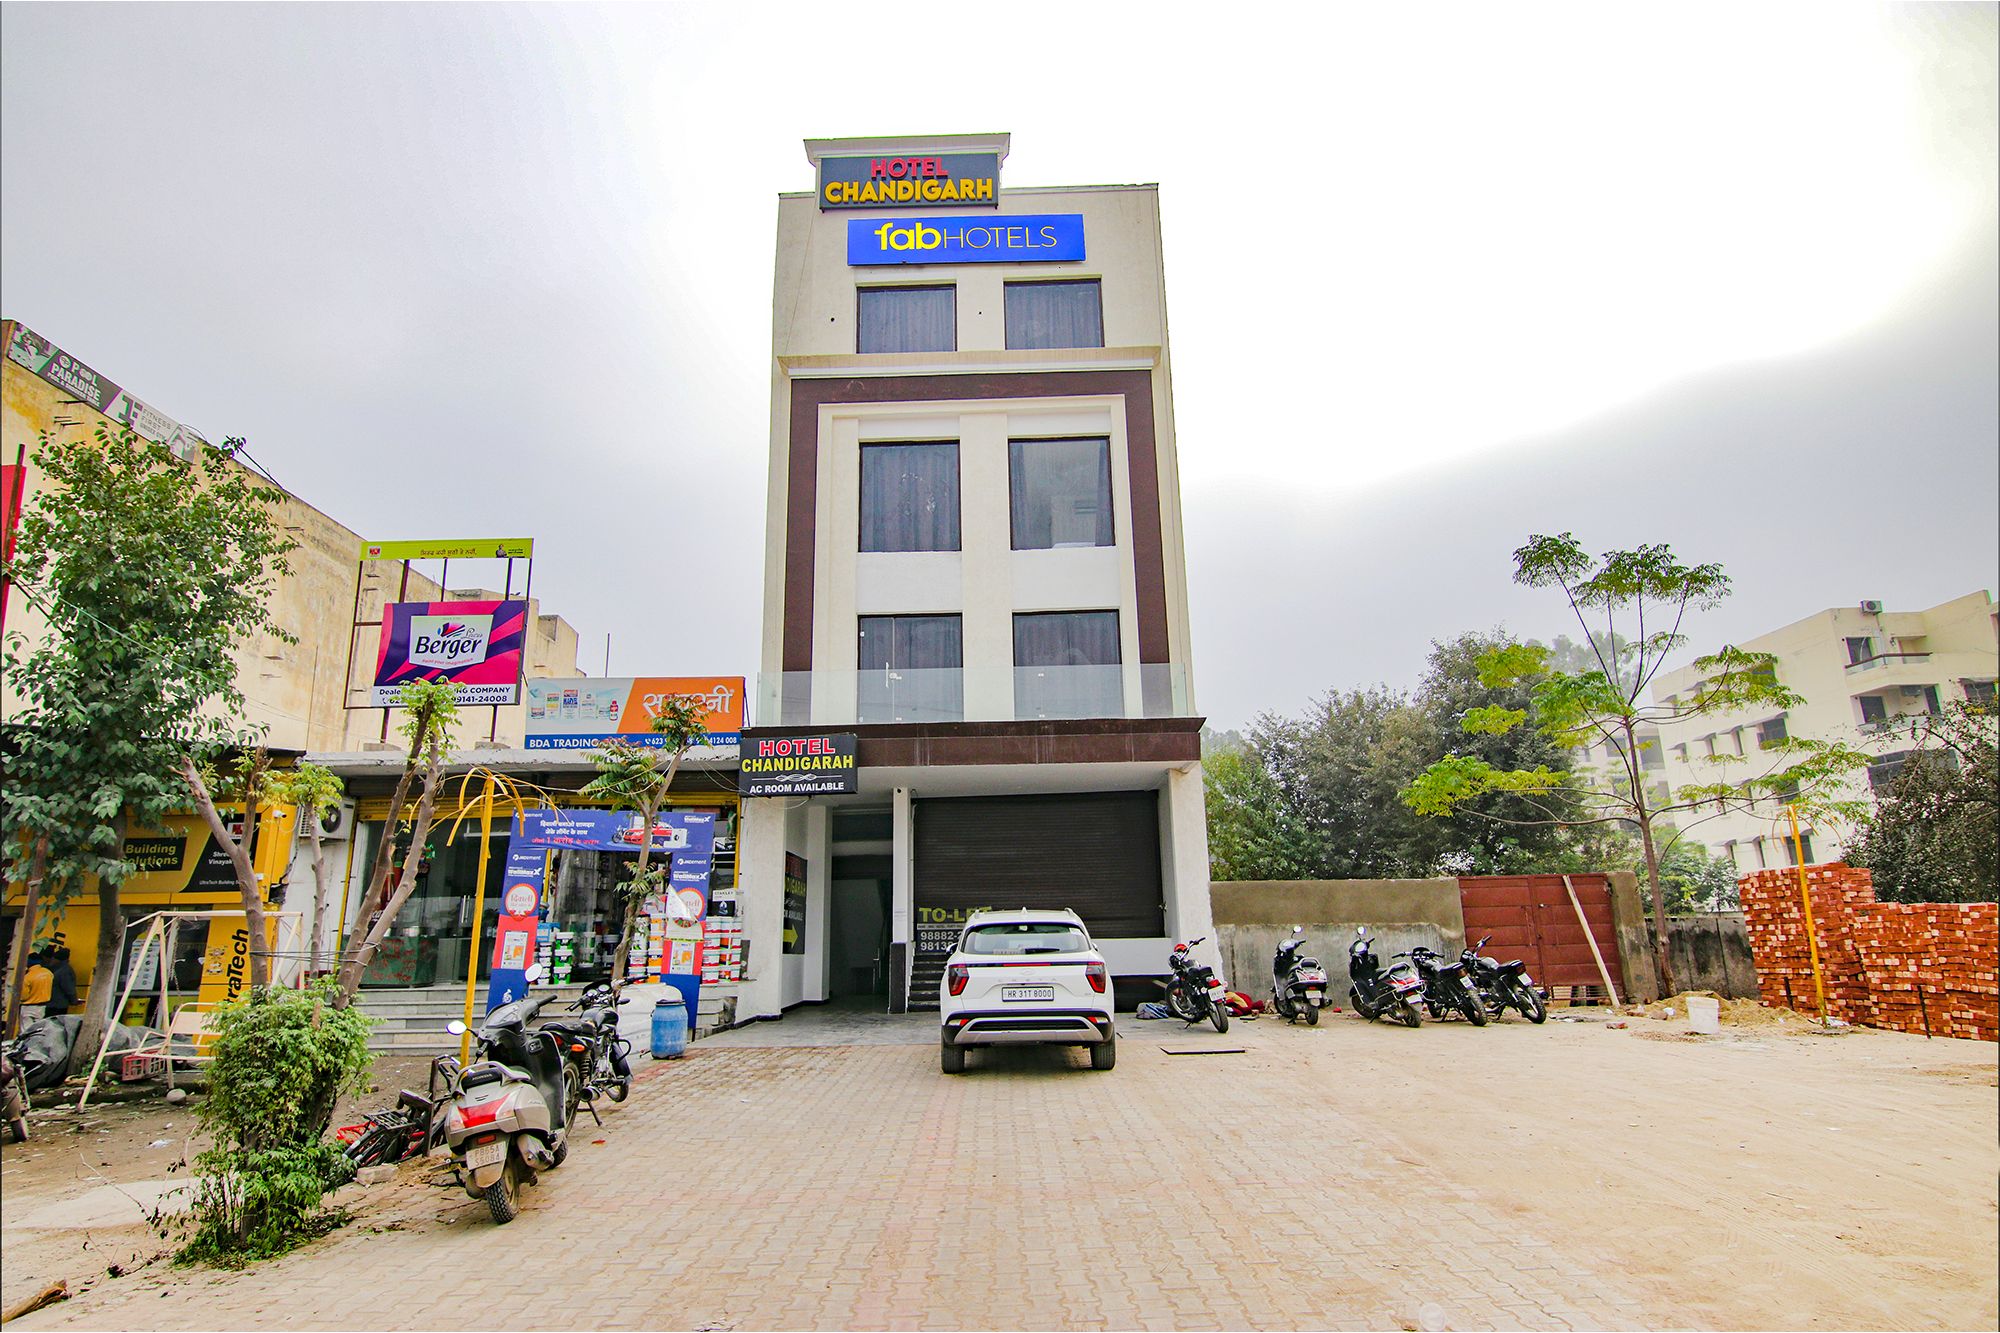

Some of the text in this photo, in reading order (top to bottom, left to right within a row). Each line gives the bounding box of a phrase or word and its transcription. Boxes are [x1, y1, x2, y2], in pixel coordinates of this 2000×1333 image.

[871, 158, 949, 180] HOTEL
[825, 179, 993, 204] CHANDIGARH
[50, 362, 101, 401] PARADISE
[142, 416, 161, 430] FIRST
[143, 408, 171, 430] FITNESS
[415, 636, 481, 659] Berger
[529, 738, 600, 748] BDA TRADING
[651, 737, 663, 745] 623
[725, 736, 737, 744] 008
[759, 738, 836, 757] HOTEL
[741, 755, 853, 772] CHANDIGARAH
[750, 782, 845, 793] AC ROOM AVAILABLE
[126, 844, 176, 855] Building
[920, 931, 961, 940] 98882-2
[1007, 990, 1052, 998] HR 31T 8000
[472, 1073, 493, 1081] HONDA
